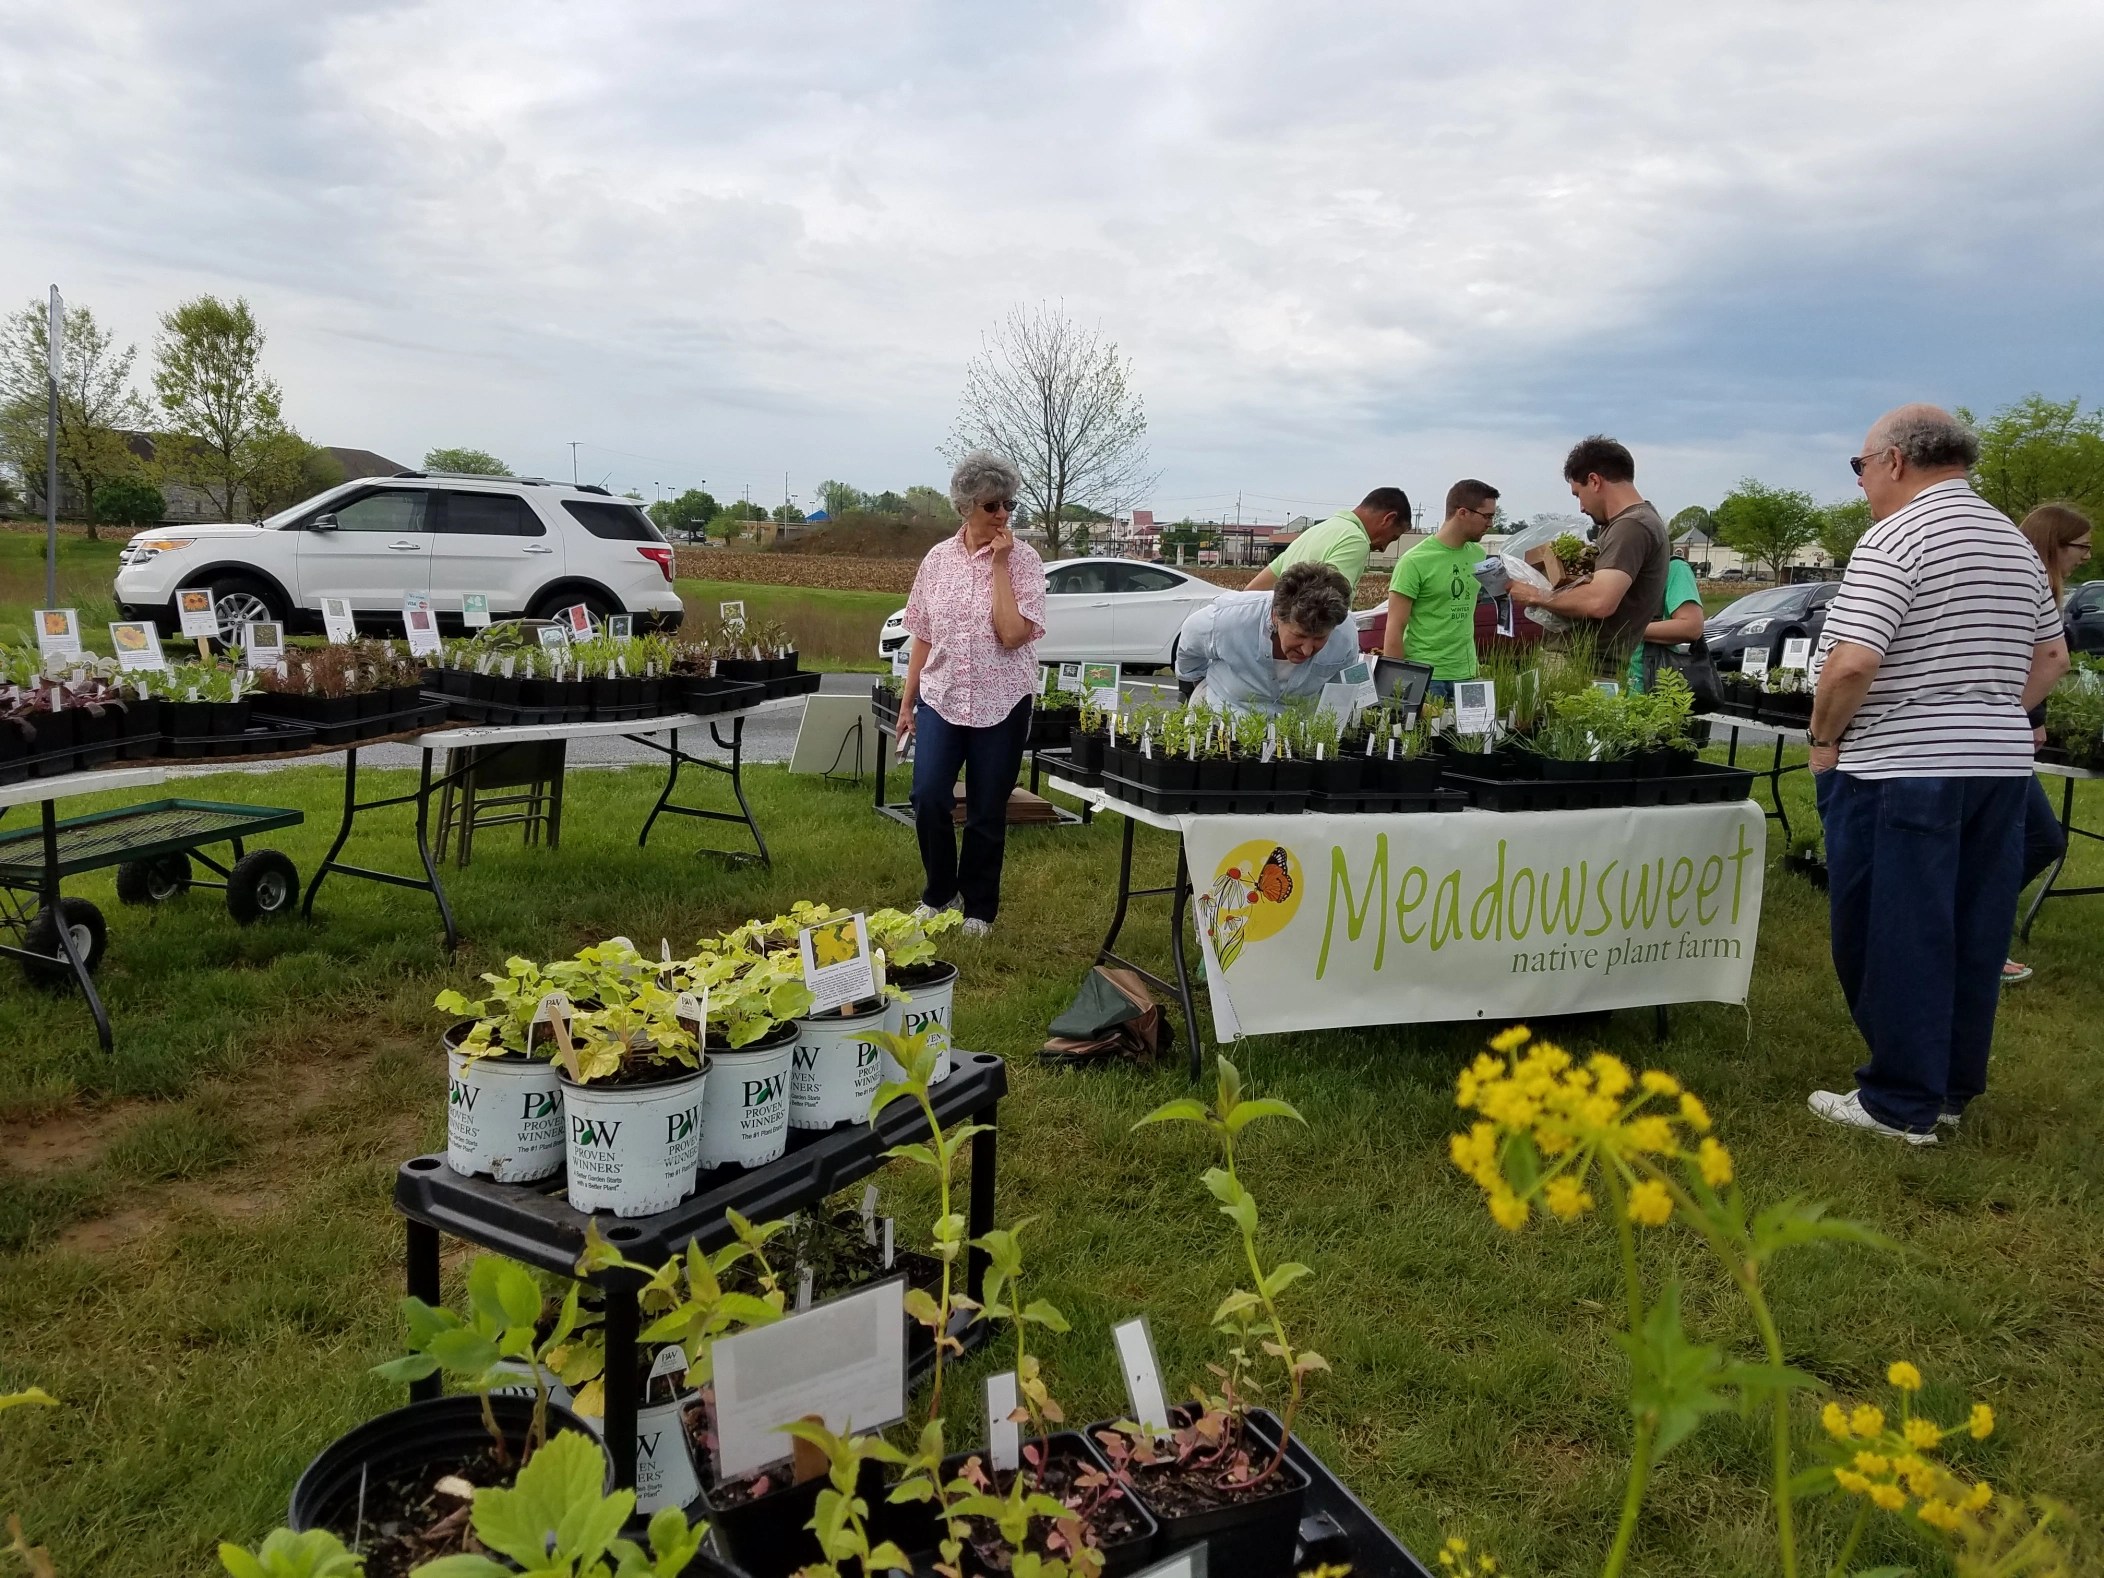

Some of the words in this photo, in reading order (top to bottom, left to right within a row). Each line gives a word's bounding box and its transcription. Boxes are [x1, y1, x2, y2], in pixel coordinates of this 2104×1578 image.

[1315, 824, 1754, 980] Meadowsweet
[1511, 942, 1598, 973] native
[1603, 937, 1672, 976] plant
[1676, 930, 1743, 960] farm
[792, 1045, 821, 1072] W
[741, 1070, 788, 1108] PW
[740, 1110, 785, 1130] WINNERS
[745, 1100, 783, 1119] PROVEN
[517, 1125, 566, 1142] WINNER
[570, 1114, 623, 1150] PW
[572, 1156, 622, 1174] WINNERS
[574, 1145, 616, 1162] PROVEN
